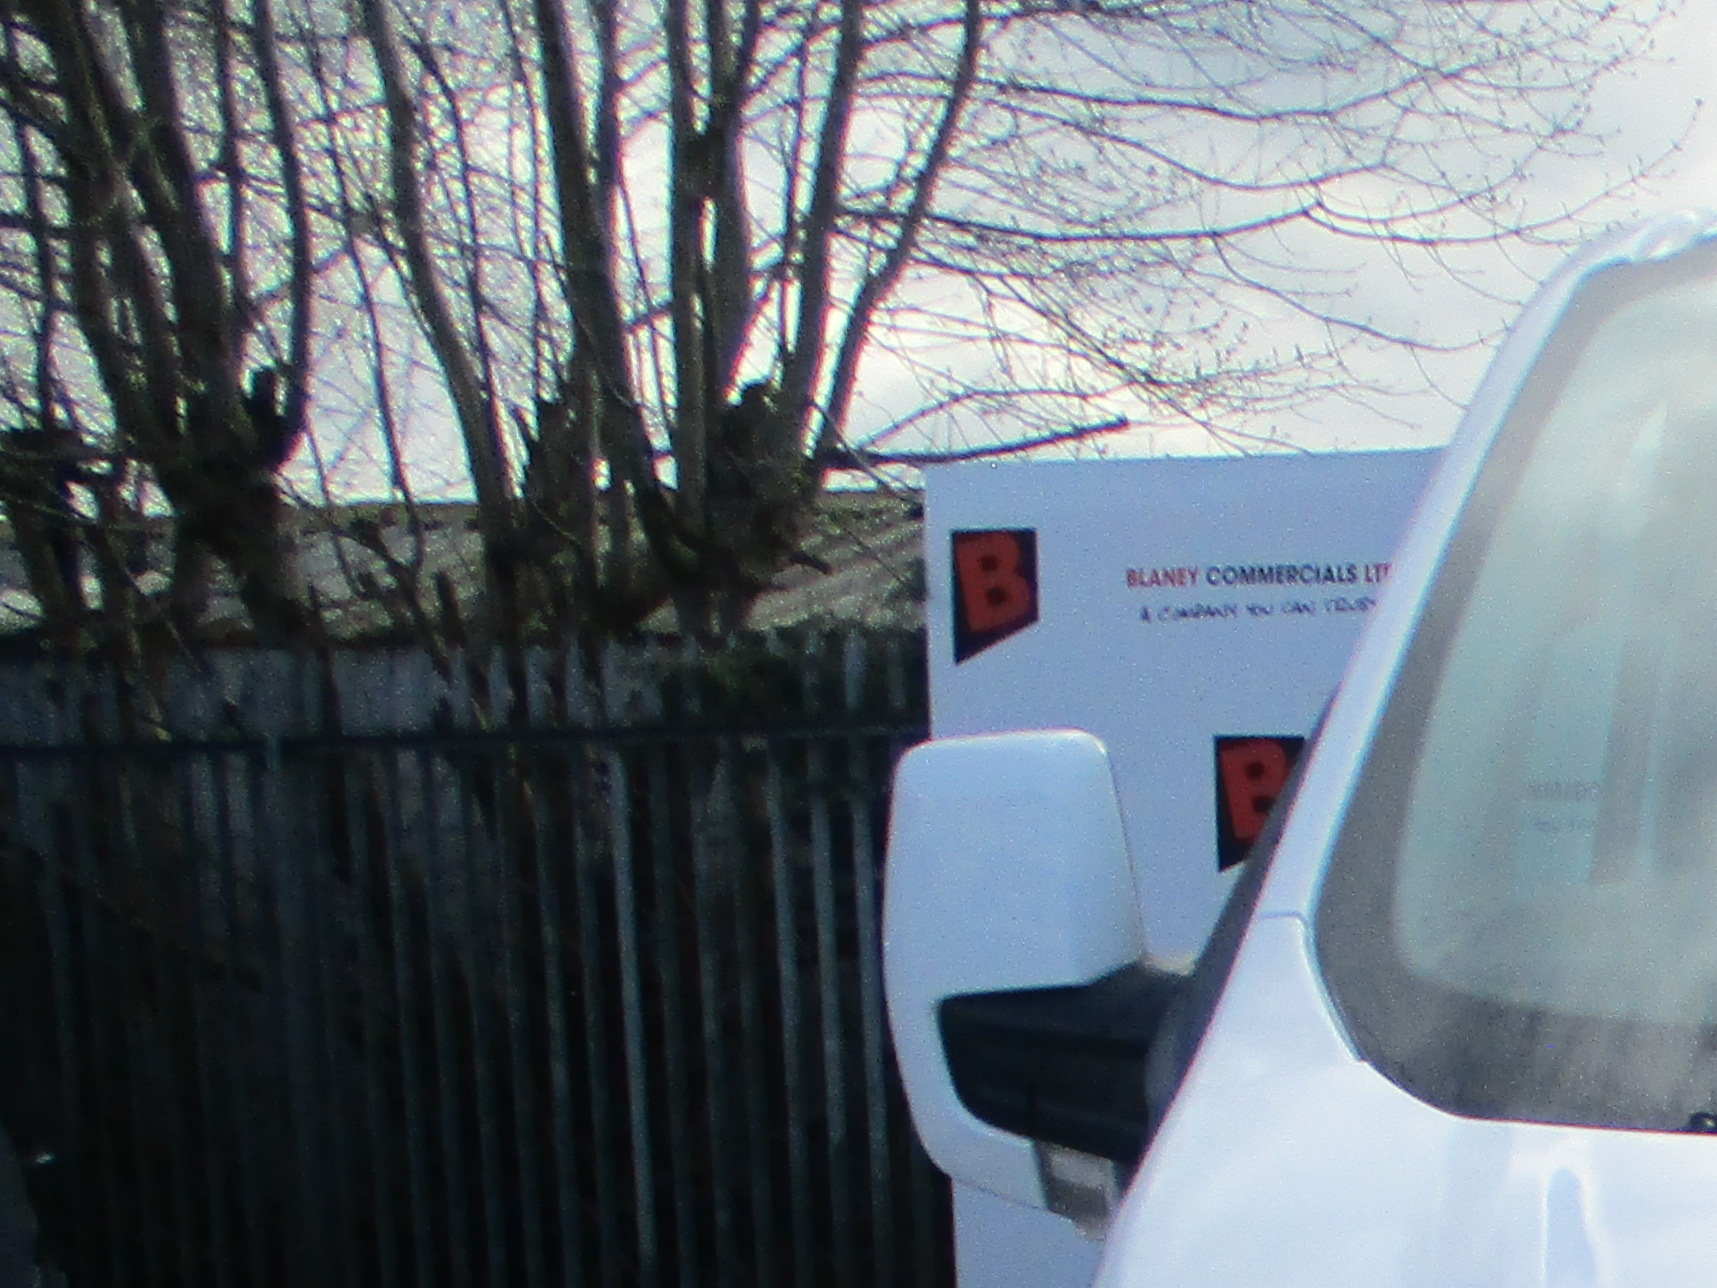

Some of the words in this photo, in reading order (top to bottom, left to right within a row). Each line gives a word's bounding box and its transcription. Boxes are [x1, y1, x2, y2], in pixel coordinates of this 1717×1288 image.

[957, 531, 1032, 634] B
[1126, 567, 1199, 588] BLANEY
[1206, 563, 1357, 586] COMMERCIALS
